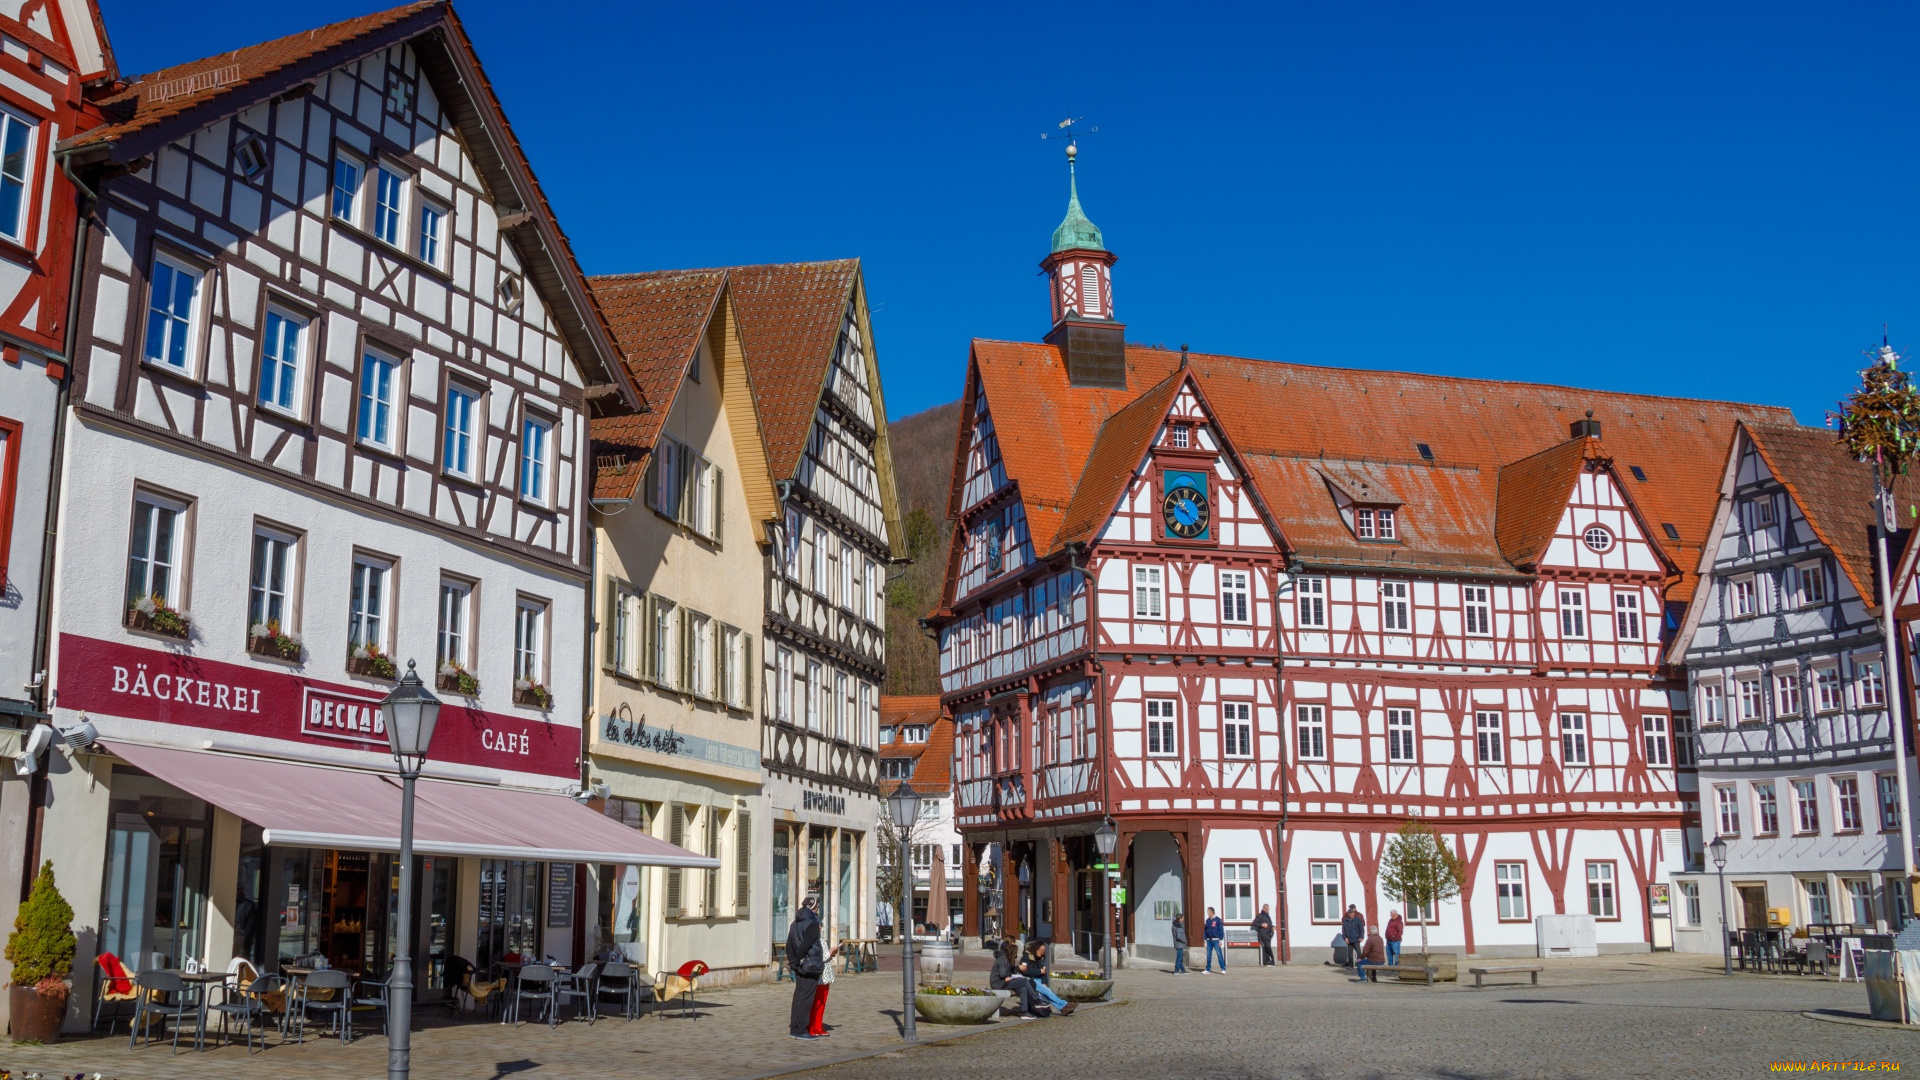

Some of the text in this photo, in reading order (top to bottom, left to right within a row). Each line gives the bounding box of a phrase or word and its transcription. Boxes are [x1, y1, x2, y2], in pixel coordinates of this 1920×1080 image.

[111, 663, 261, 714] BÄCKEREI
[310, 699, 385, 734] BECKAB
[481, 728, 529, 756] CAFÉ
